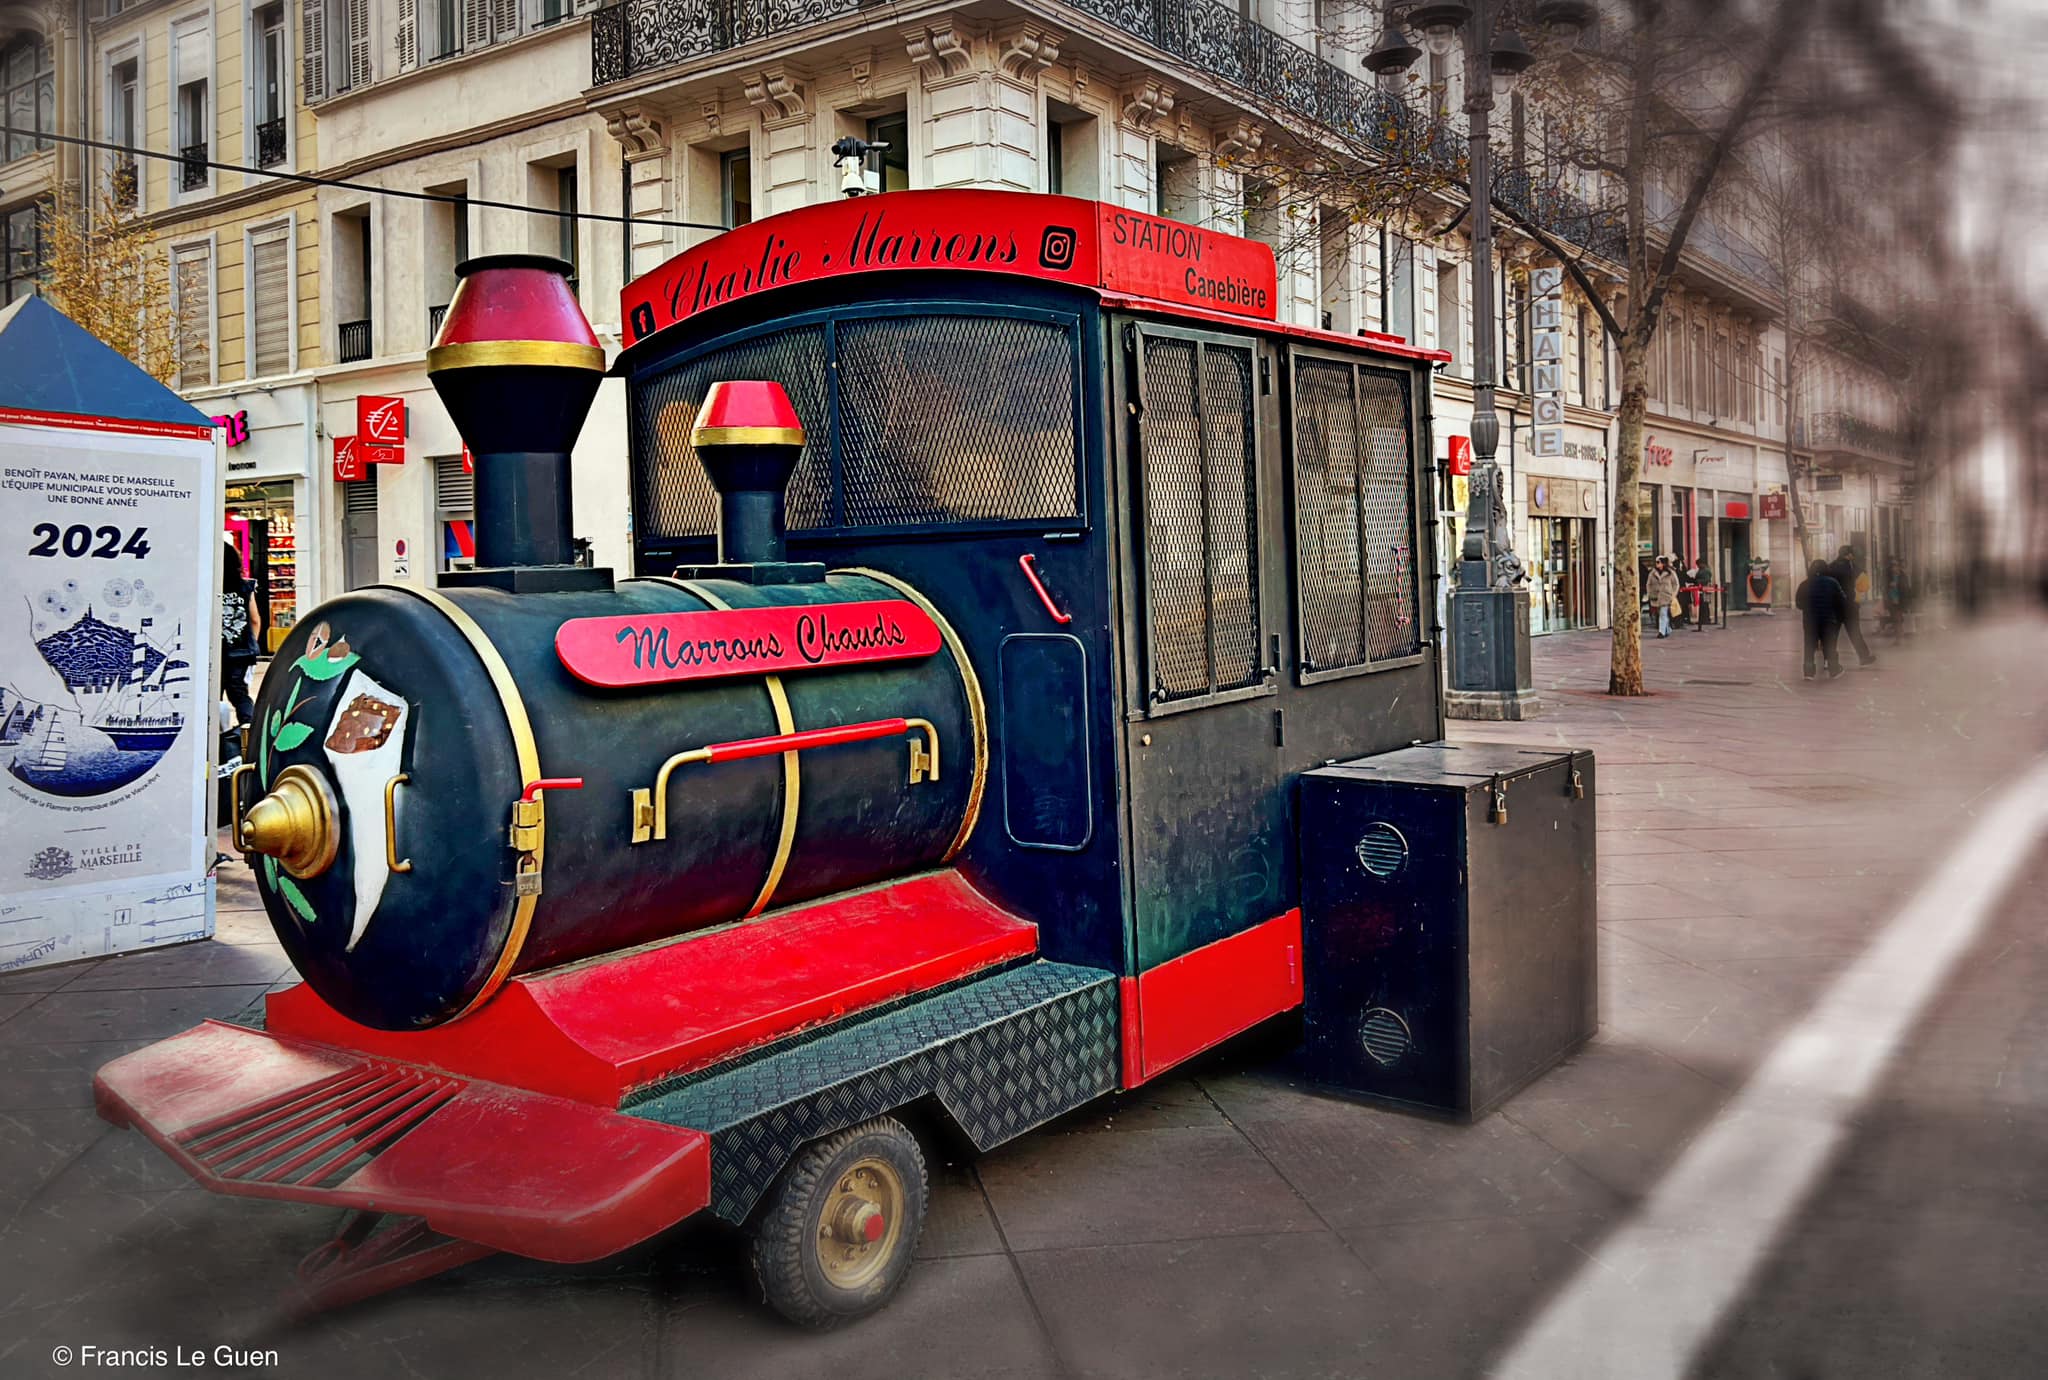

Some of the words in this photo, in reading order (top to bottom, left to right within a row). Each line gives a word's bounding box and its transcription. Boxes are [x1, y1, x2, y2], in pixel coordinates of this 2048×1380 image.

[1113, 213, 1203, 261] STATION
[663, 234, 801, 321] Charlie
[822, 210, 1019, 269] Marrons
[1185, 267, 1267, 309] Canebière
[1535, 270, 1556, 454] CHANGE
[1643, 435, 1673, 474] free
[4, 468, 41, 479] BENOÎT
[44, 471, 78, 482] PAYAN,
[80, 474, 110, 483] MAIRE
[112, 475, 125, 484] DE
[127, 477, 175, 487] MARSEILLE
[46, 483, 104, 494] MUNICIPALE
[107, 486, 133, 496] VOUS
[134, 488, 192, 499] SOUHAITENT
[47, 494, 68, 504] UNE
[70, 495, 104, 505] BONNE
[106, 497, 138, 507] ANNÉE
[28, 522, 151, 559] 2024
[616, 625, 784, 670] Marrons
[796, 614, 905, 664] Chauds
[80, 851, 142, 869] MARSEILLE
[82, 846, 117, 856] VILLE
[127, 843, 141, 851] DE
